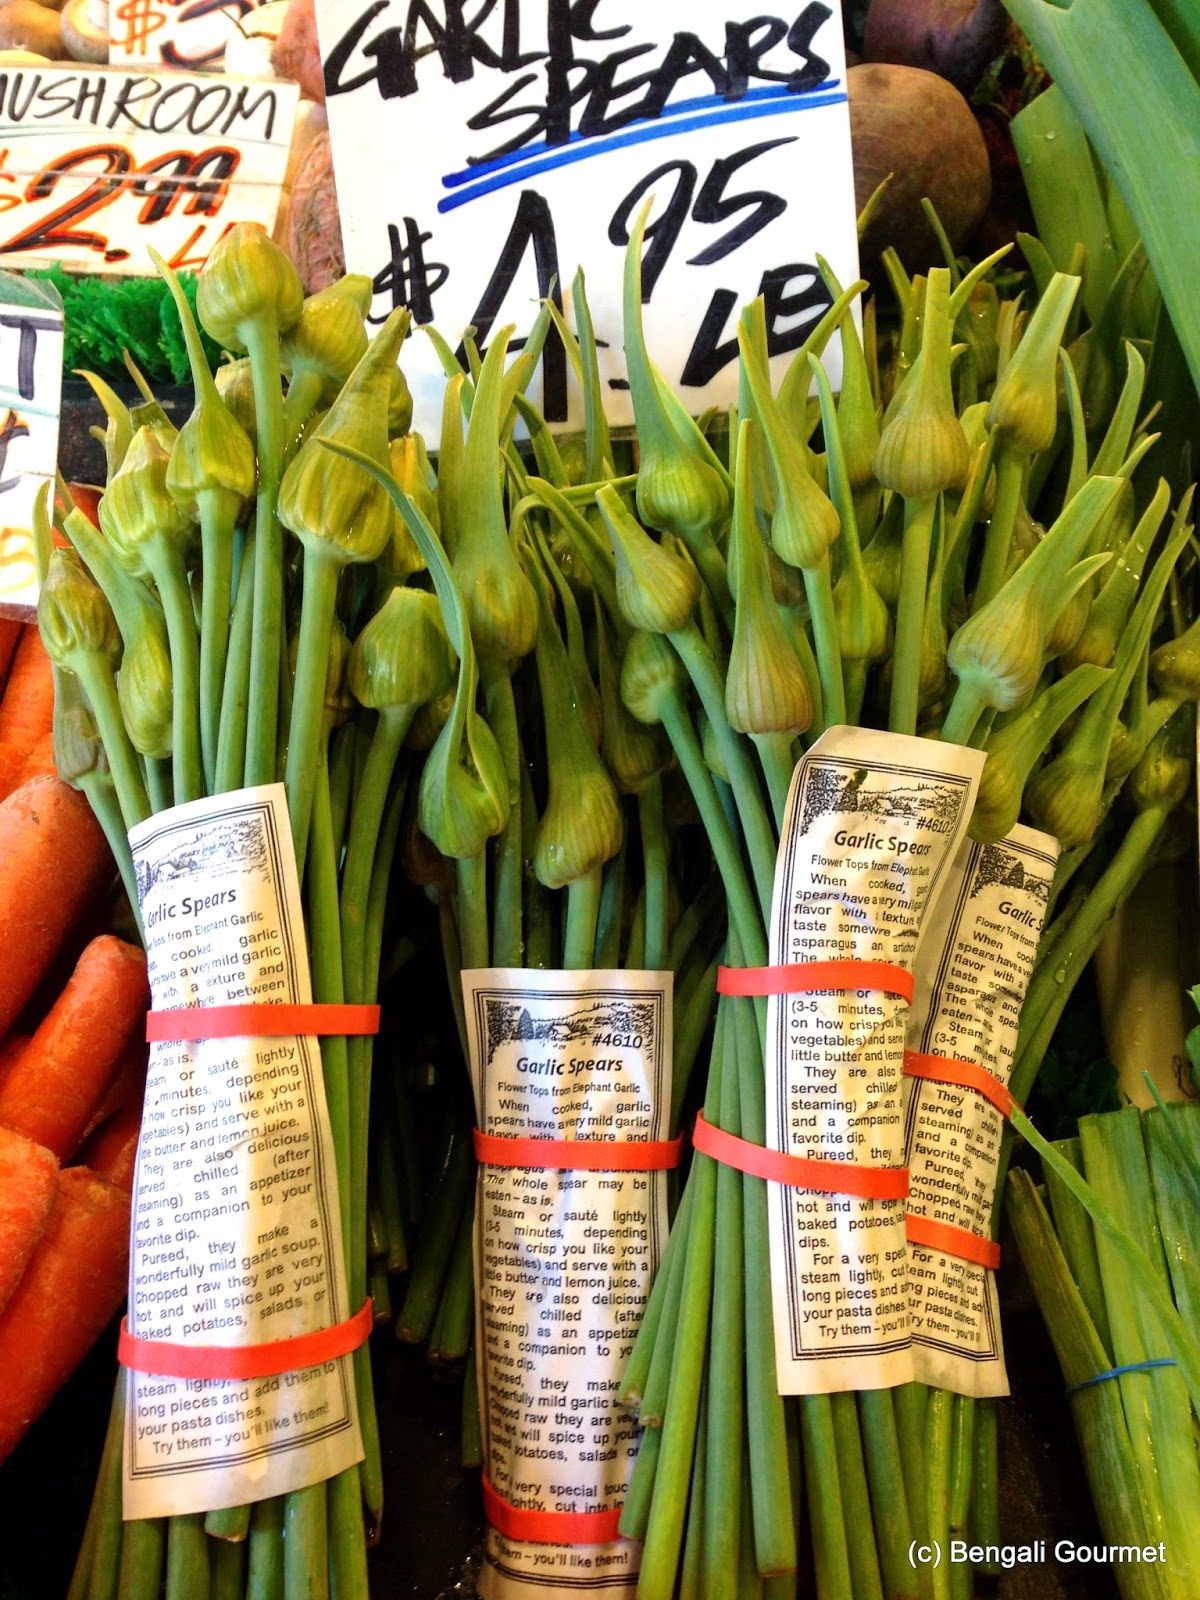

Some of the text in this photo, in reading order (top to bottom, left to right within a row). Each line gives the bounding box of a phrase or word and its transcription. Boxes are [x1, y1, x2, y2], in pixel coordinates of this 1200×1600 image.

[325, 0, 632, 98] GARLIC
[466, 2, 833, 164] SPEARS
[834, 830, 932, 857] Garlic Spears
[811, 854, 890, 871] Flower Tops from
[810, 873, 847, 887] When
[182, 889, 236, 917] Spears
[796, 890, 873, 905] spears have
[794, 903, 867, 919] flavor with
[998, 900, 1038, 928] Garlic
[168, 912, 263, 942] from Garlic
[793, 919, 827, 931] taste
[975, 915, 1006, 933] Flower
[239, 928, 278, 948] garlic
[793, 938, 857, 951] asparagus
[973, 930, 1003, 950] When
[242, 946, 281, 965] garlic
[957, 942, 995, 961] spears
[259, 961, 284, 976] and
[950, 966, 978, 984] taste
[954, 953, 1014, 983] flavor with
[227, 980, 285, 1000] between
[792, 1000, 886, 1017] (3-5 minutes,
[591, 1033, 643, 1049] #4610
[791, 1034, 867, 1048] vegetables)
[256, 1046, 295, 1065] lightly
[791, 1049, 862, 1062] little butter
[516, 1057, 623, 1077] Garlic Spears
[804, 1066, 867, 1080] They are
[226, 1064, 299, 1088] depending
[498, 1081, 640, 1097] Flower Tops from Elephant Garlic
[791, 1083, 837, 1094] served
[172, 1081, 302, 1117] crisp like your
[791, 1099, 857, 1113] steaming)
[936, 1089, 965, 1107] They
[196, 1100, 293, 1131] and serve with
[498, 1099, 651, 1115] When cooked, garlic
[921, 1102, 963, 1119] served
[487, 1115, 650, 1130] spears have mild garlic
[847, 1113, 900, 1128] companion
[190, 1118, 300, 1149] and lemon juice.
[792, 1132, 843, 1144] favorite
[173, 1132, 309, 1169] are also delicious
[870, 1147, 892, 1161] they
[194, 1149, 311, 1183] chilled (after
[250, 1166, 312, 1193] appetizer
[486, 1174, 624, 1194] The whole may
[174, 1183, 312, 1223] companion your
[563, 1210, 647, 1225] sauté lightly
[797, 1217, 837, 1231] baked
[175, 1230, 200, 1246] dip.
[514, 1226, 648, 1241] minutes, depending
[142, 1226, 289, 1267] Pureed, they make
[525, 1242, 649, 1255] crisp you like your
[798, 1236, 830, 1251] dips.
[210, 1237, 320, 1272] mild garlic soup.
[197, 1254, 323, 1293] raw they are very
[545, 1259, 636, 1271] and serve with
[505, 1271, 641, 1291] butter lemon juice.
[801, 1271, 840, 1284] steam
[160, 1271, 324, 1318] and will spice your
[592, 1293, 647, 1305] delicious
[835, 1287, 878, 1303] pieces
[183, 1297, 303, 1335] potatoes, salads
[803, 1305, 872, 1323] your pasta
[818, 1323, 871, 1339] Try them
[518, 1342, 586, 1357] companion
[138, 1381, 176, 1398] steam
[138, 1367, 321, 1417] long pieces and add them
[538, 1395, 610, 1411] mild garlic
[138, 1406, 265, 1440] your pasta dishes.
[152, 1401, 329, 1455] Try them like them!
[554, 1413, 611, 1429] they are
[548, 1430, 585, 1445] spice
[549, 1485, 598, 1497] special
[570, 1554, 592, 1568] like
